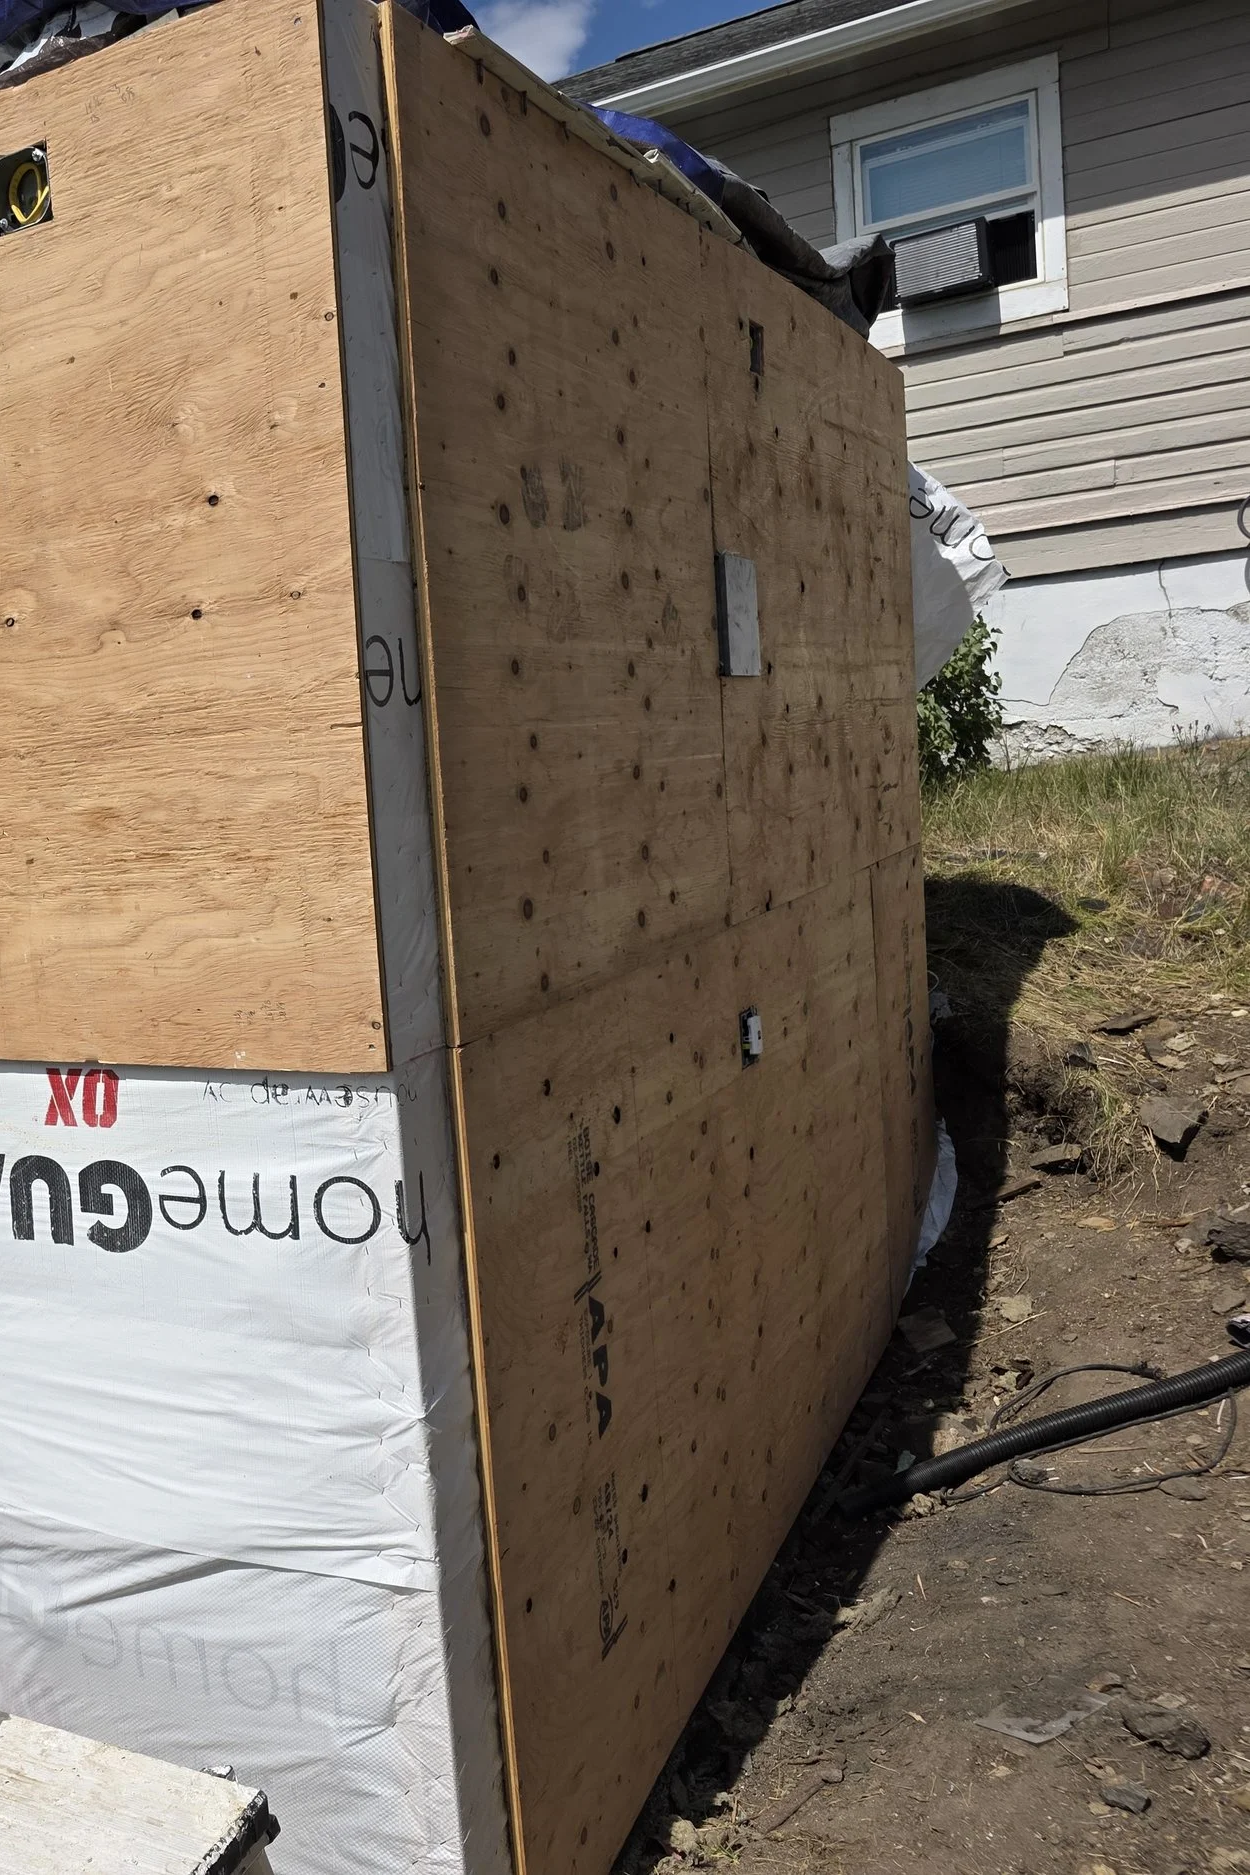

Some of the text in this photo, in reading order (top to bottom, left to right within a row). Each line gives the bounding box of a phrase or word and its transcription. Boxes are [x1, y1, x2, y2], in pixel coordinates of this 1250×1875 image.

[44, 1068, 119, 1128] OX
[588, 1192, 600, 1271] CASCADE
[588, 1295, 613, 1441] APA
